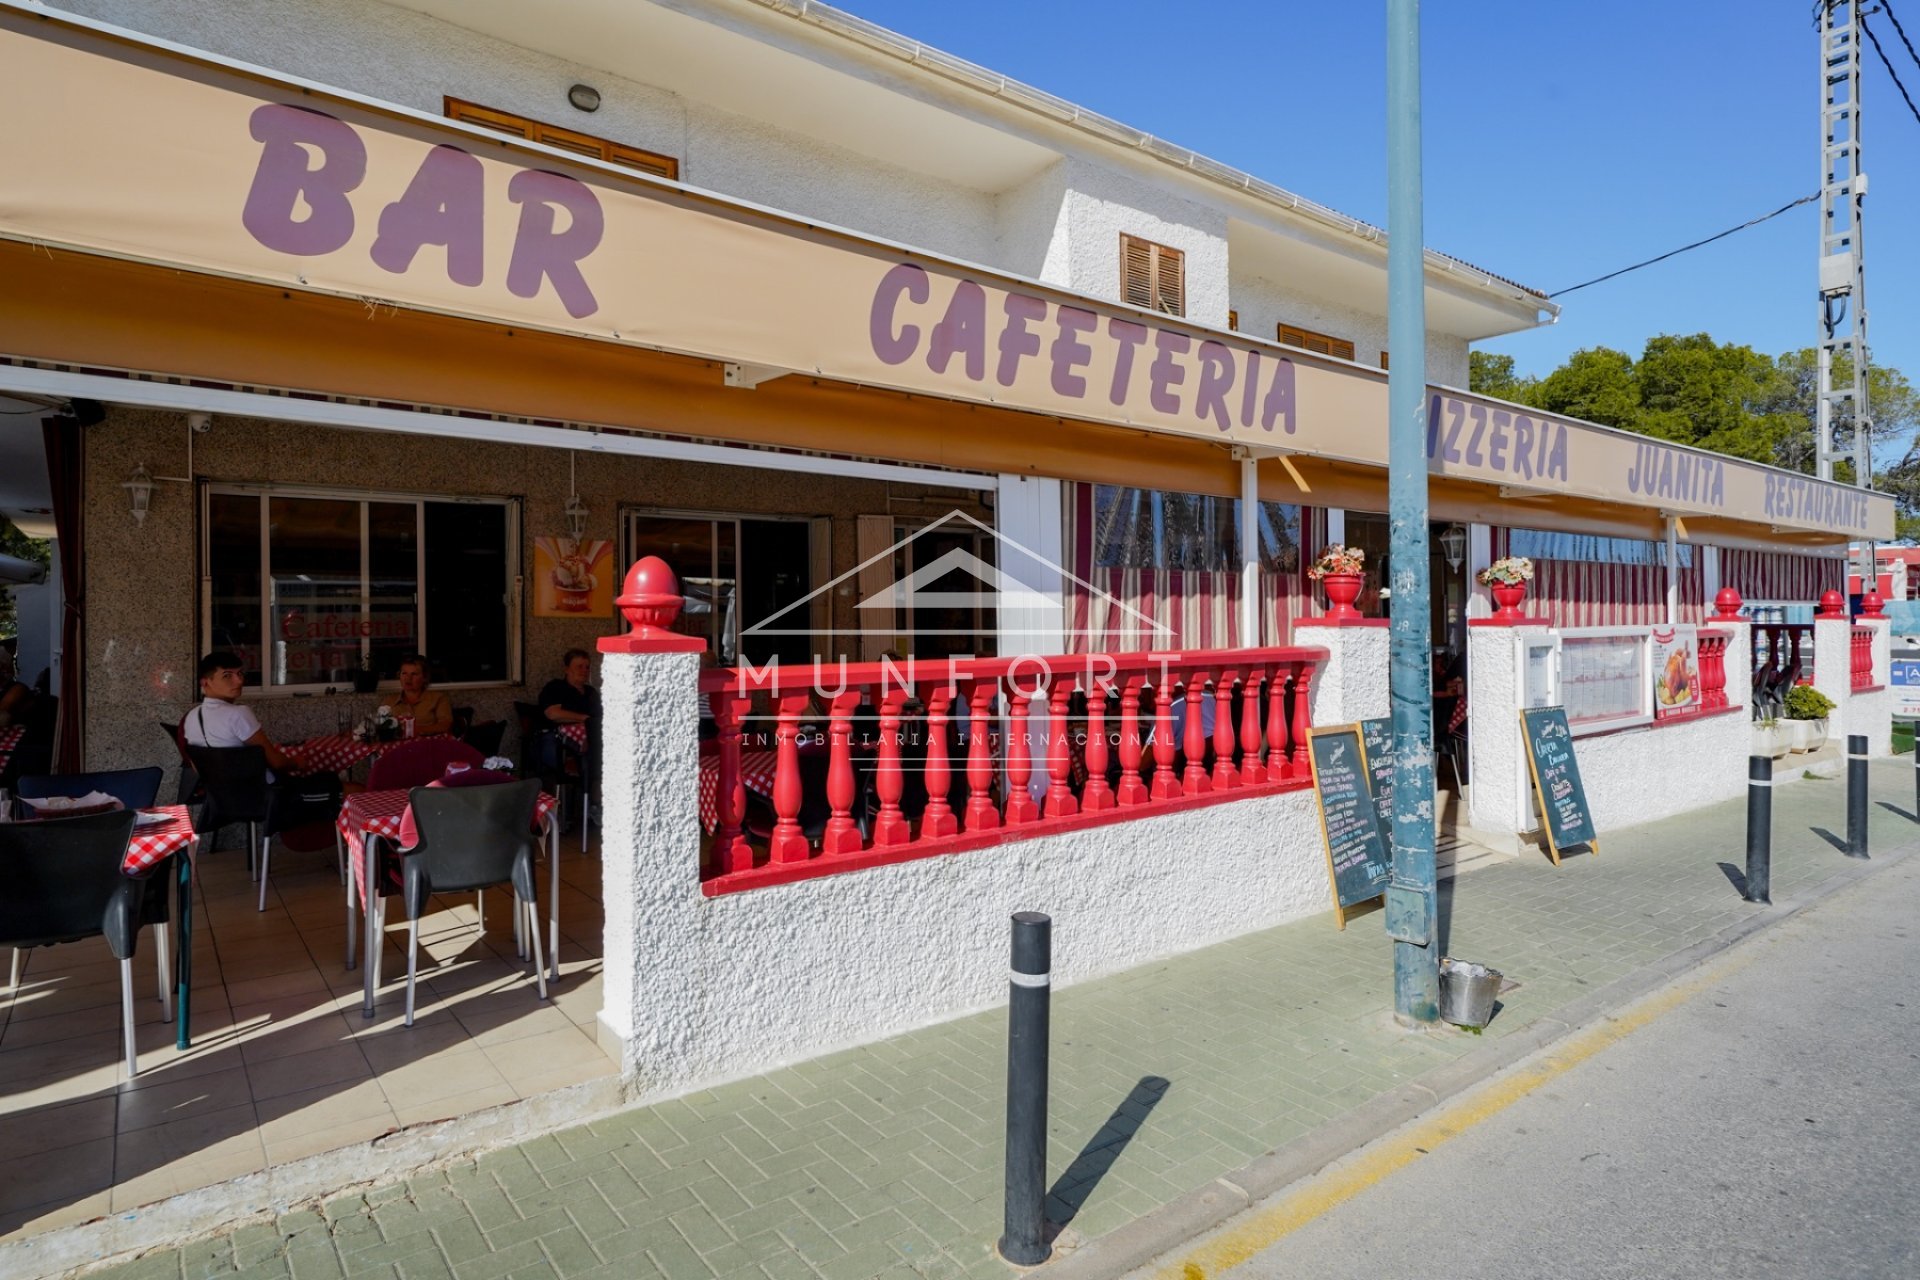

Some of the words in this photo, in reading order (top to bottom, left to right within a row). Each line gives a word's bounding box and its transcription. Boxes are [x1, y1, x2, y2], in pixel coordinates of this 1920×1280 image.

[242, 103, 604, 319] BAR
[870, 263, 1296, 434] CAFETERIA
[1427, 394, 1567, 482] IZZERIA
[1628, 443, 1723, 507] JUANITA
[1765, 472, 1868, 529] RESTAURANTE
[282, 608, 409, 638] Cafeteria
